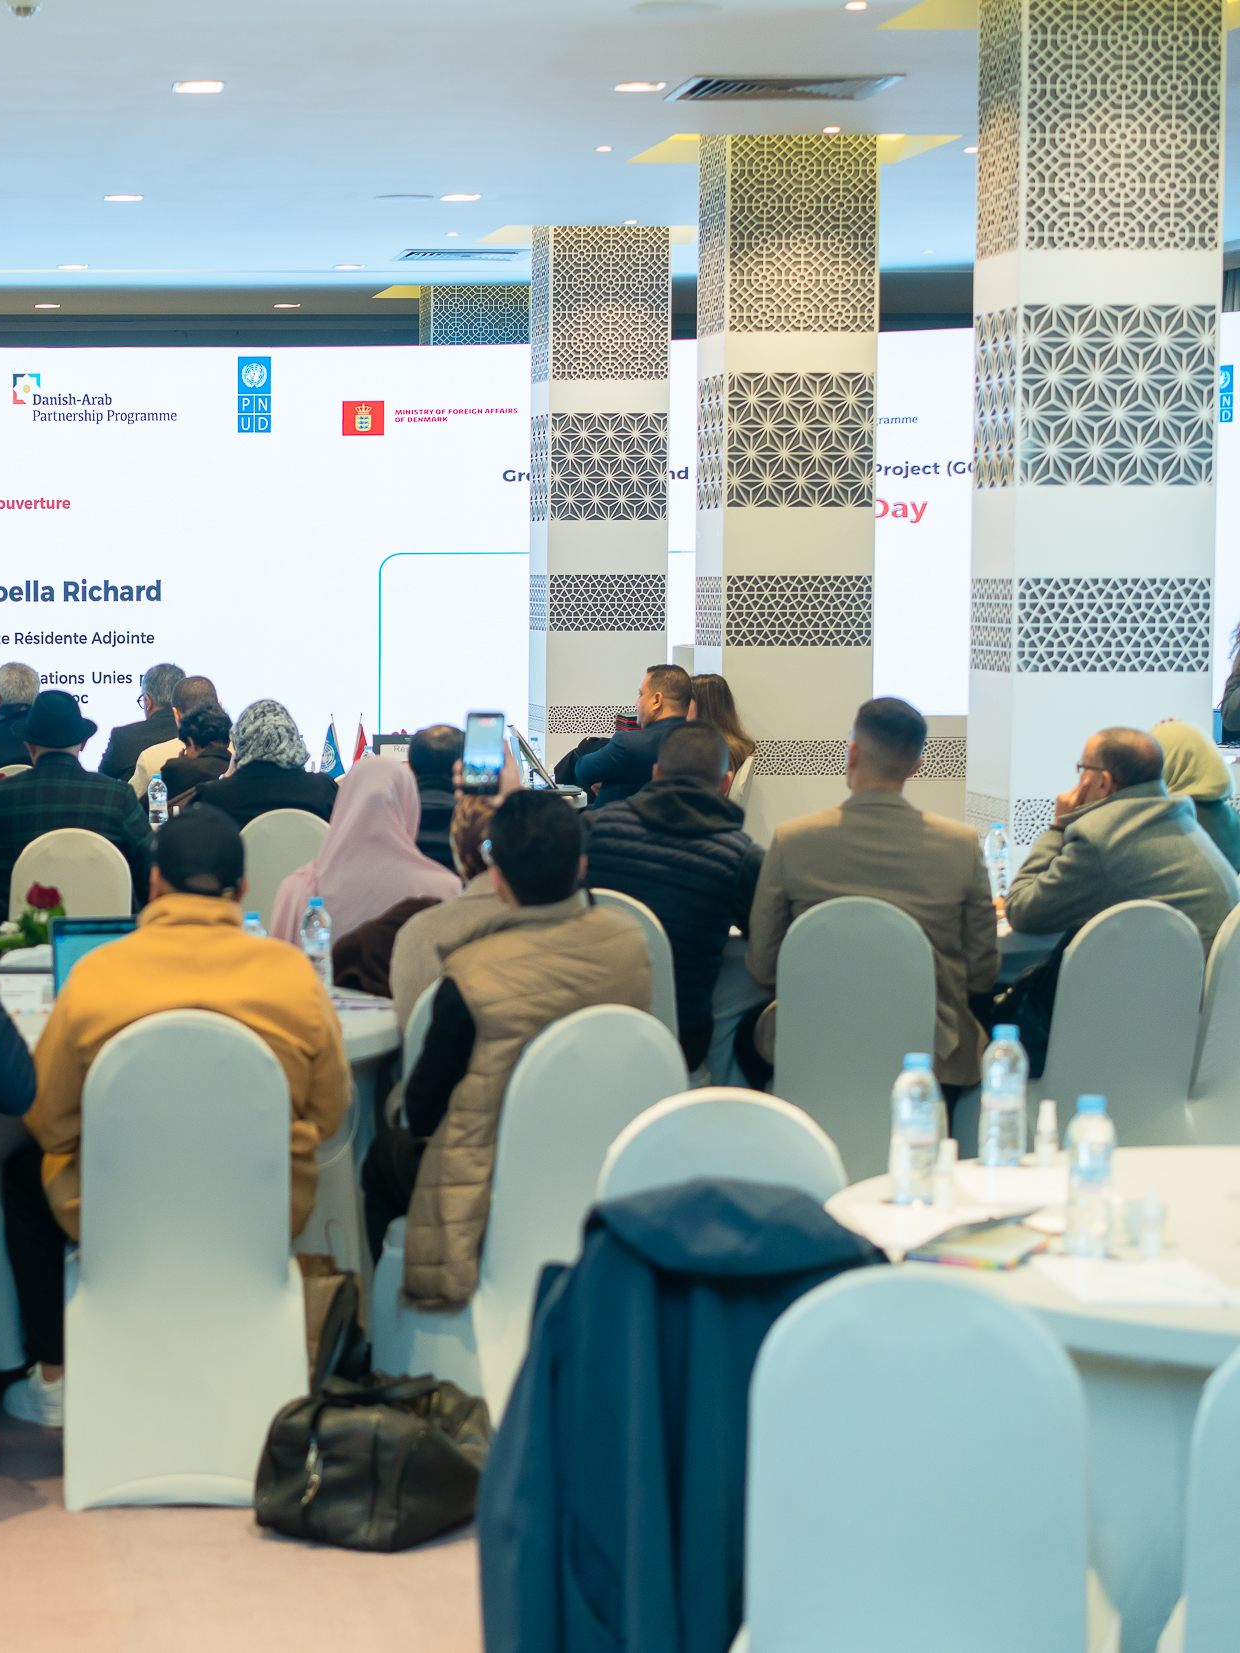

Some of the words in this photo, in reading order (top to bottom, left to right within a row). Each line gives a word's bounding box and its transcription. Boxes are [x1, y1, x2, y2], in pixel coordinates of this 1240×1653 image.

[32, 394, 112, 406] Danish-Arab
[32, 409, 104, 425] Partnership
[107, 410, 177, 425] Programme
[876, 416, 918, 426] ramme
[63, 578, 162, 602] Richard
[14, 631, 88, 645] Résidente
[91, 631, 155, 647] Adjointe
[37, 672, 85, 685] ations
[91, 671, 133, 684] Unies
